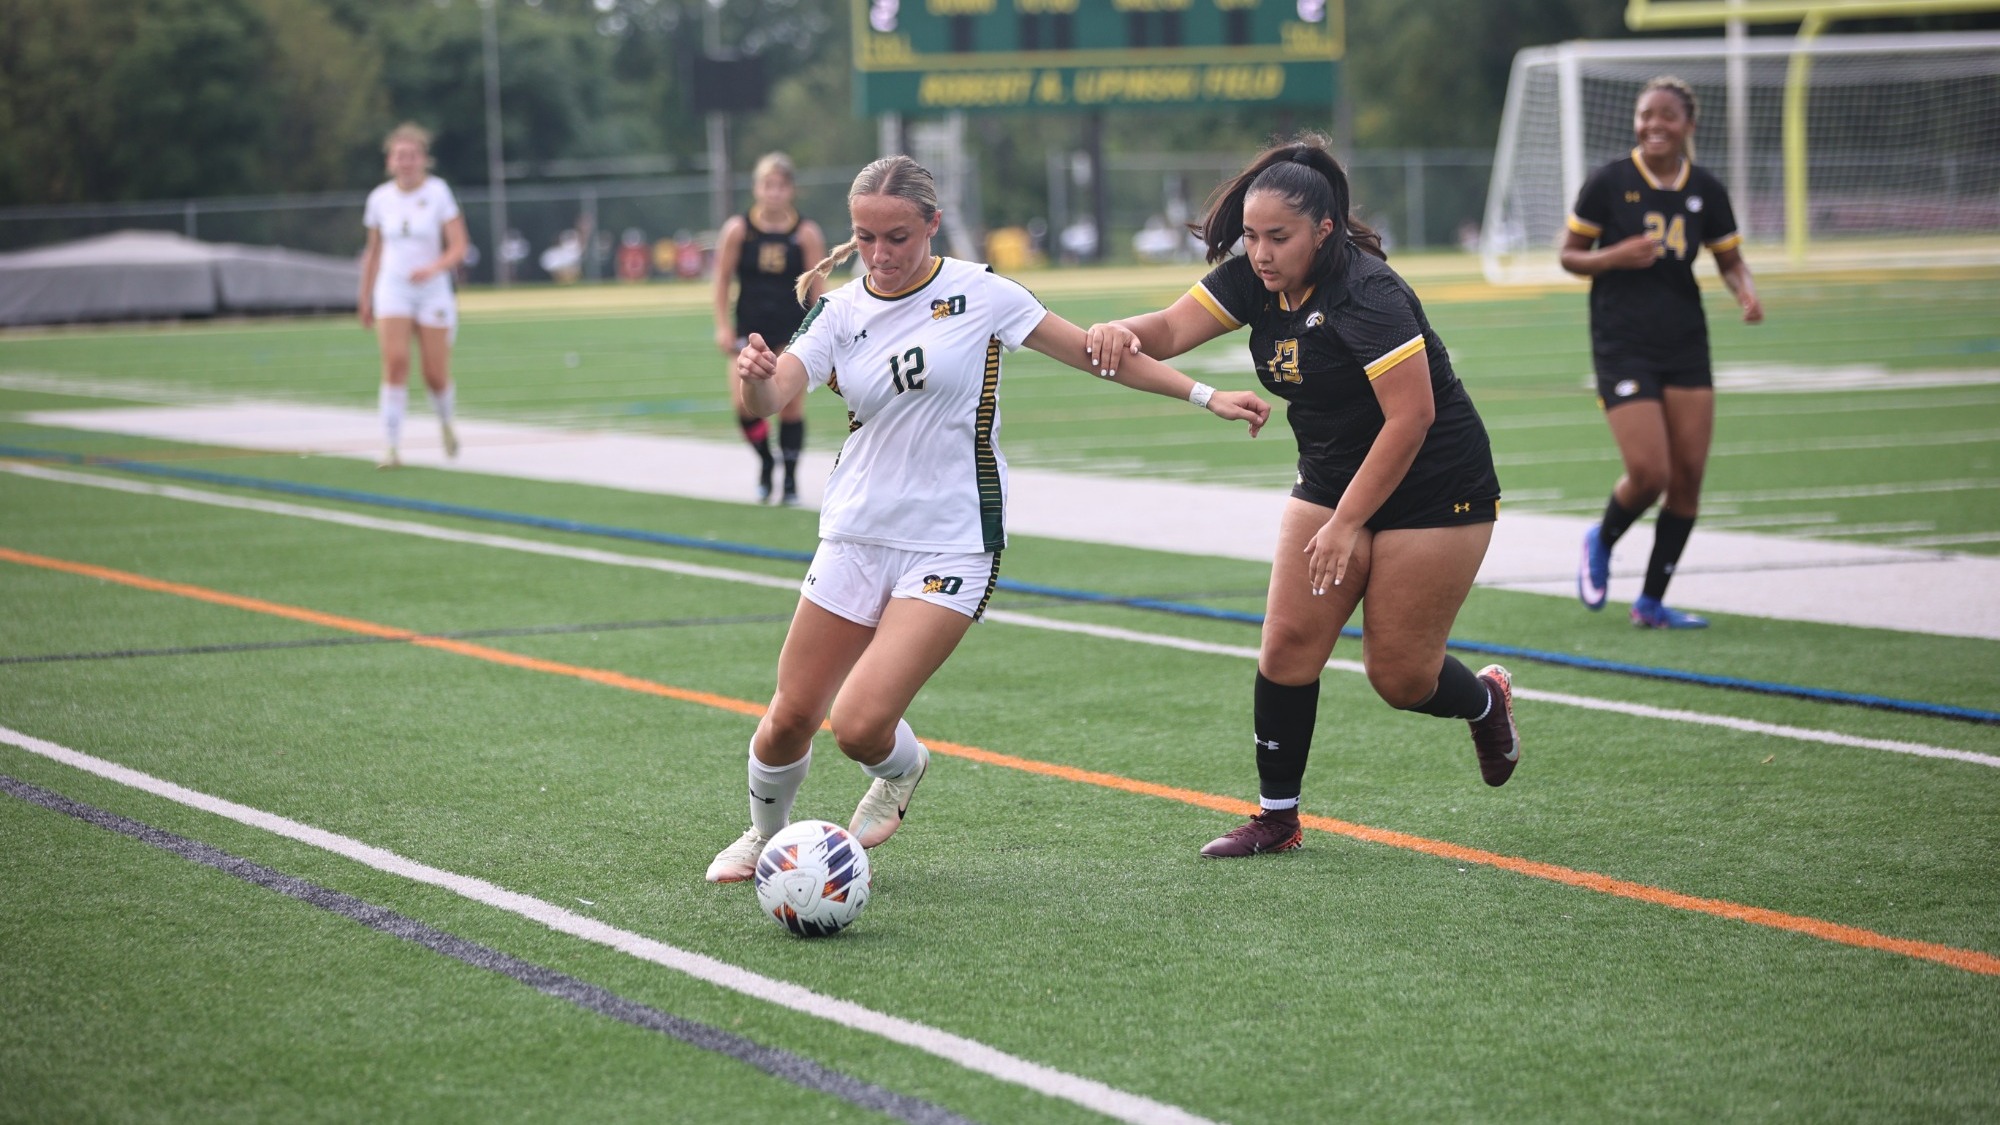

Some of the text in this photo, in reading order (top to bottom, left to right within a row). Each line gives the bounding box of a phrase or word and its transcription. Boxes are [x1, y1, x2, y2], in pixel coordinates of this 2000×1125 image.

[1643, 211, 1687, 260] 24
[889, 346, 926, 396] 12
[1267, 338, 1303, 385] 13
